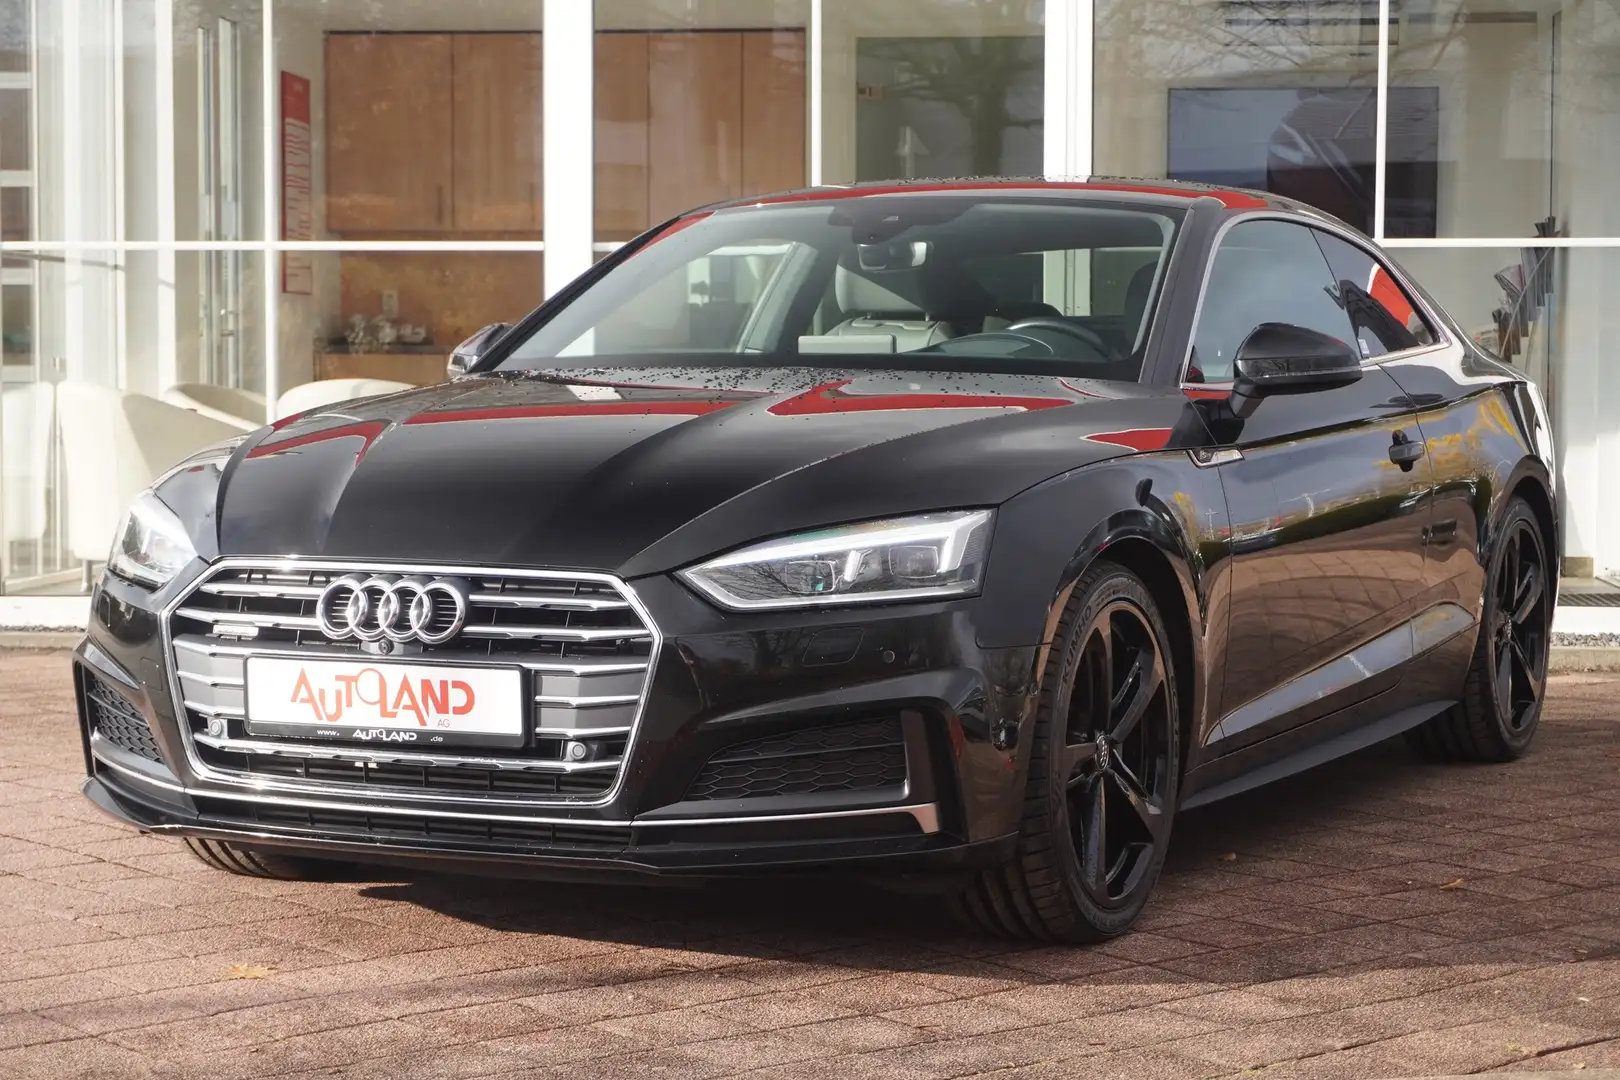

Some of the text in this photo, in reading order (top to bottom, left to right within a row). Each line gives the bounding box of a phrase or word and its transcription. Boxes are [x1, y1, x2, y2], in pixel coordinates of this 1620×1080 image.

[1062, 605, 1092, 685] KUMHO
[290, 667, 475, 726] AUTOLAND
[352, 728, 417, 742] AUTOLAND
[437, 718, 450, 728] AG
